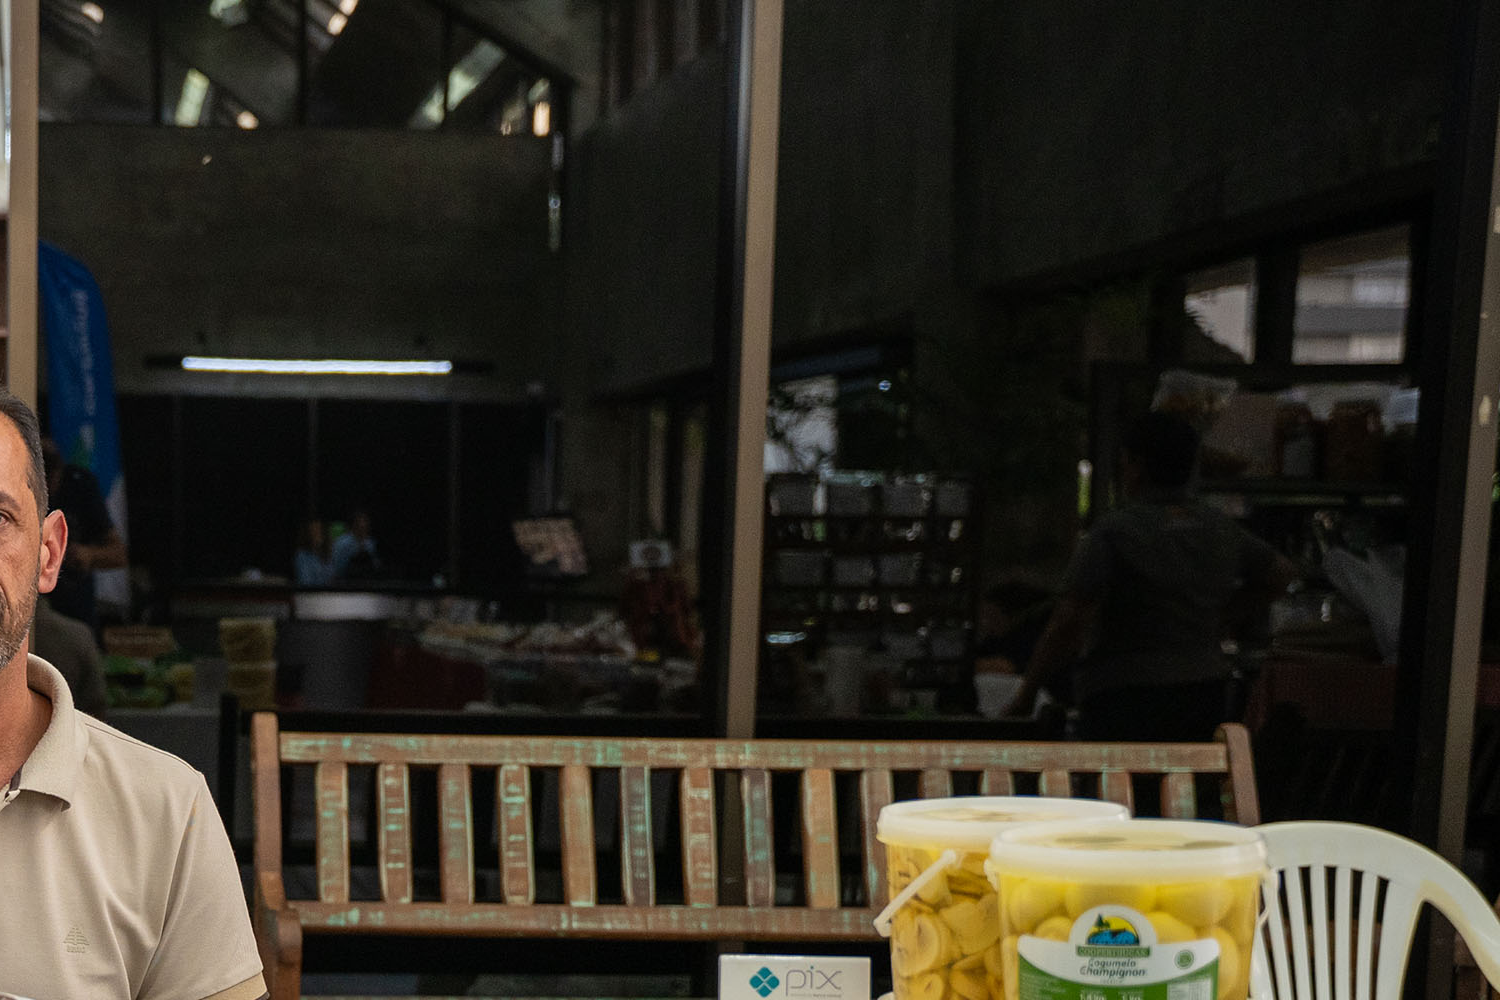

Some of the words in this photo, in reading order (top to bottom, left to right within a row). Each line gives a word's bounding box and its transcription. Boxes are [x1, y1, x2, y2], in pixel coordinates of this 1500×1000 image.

[1088, 958, 1136, 971] Cogumelo
[1080, 966, 1146, 978] Champignon
[786, 965, 842, 997] pix
